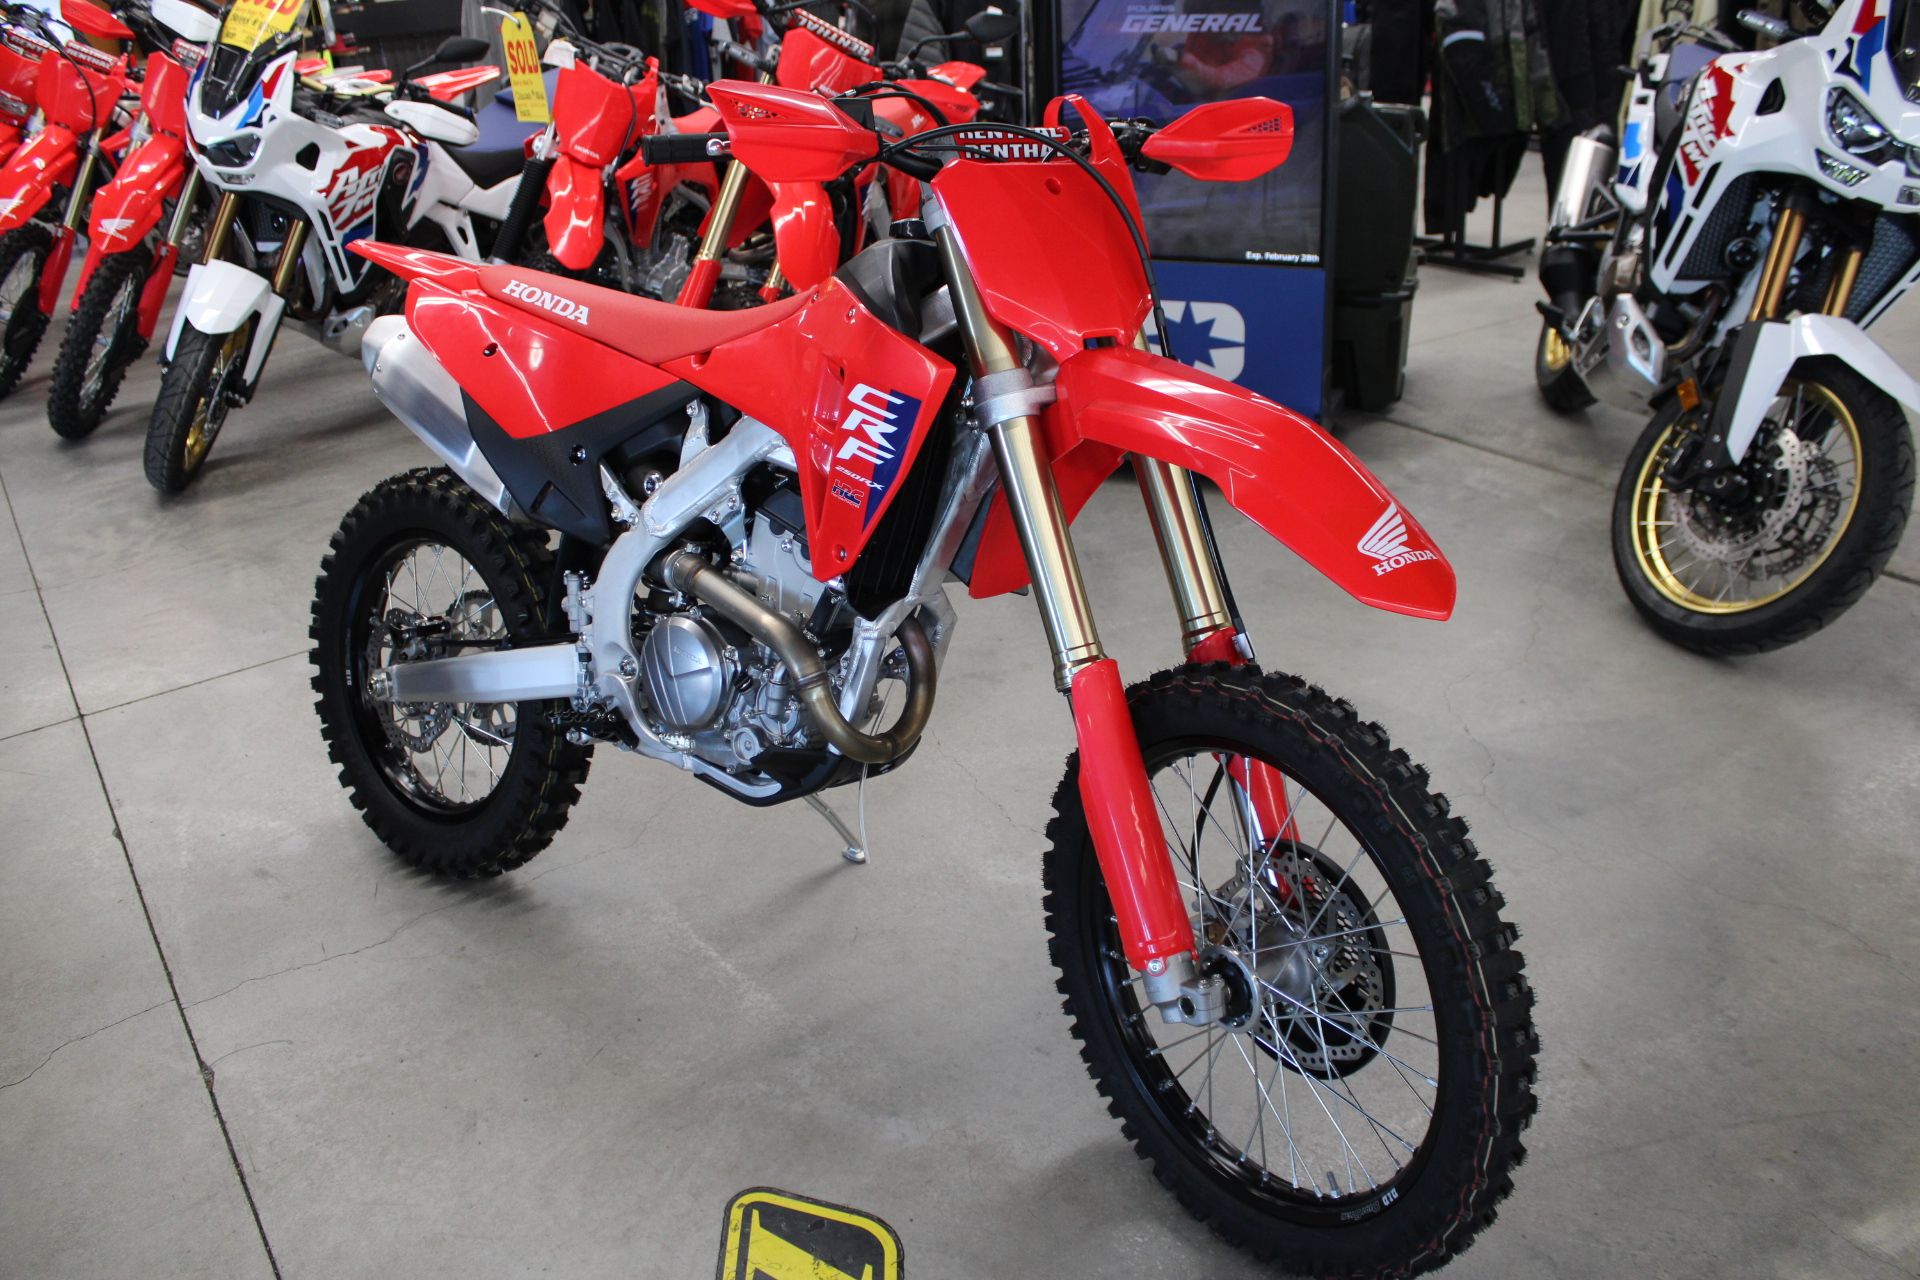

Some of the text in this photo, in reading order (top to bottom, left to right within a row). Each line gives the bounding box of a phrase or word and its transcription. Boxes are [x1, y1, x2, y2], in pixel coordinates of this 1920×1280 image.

[1120, 14, 1263, 32] GENERAL
[507, 40, 538, 75] SOLD
[1246, 251, 1320, 263] Exp. February 28th
[502, 279, 588, 325] HONDA
[836, 383, 905, 465] CRF
[835, 466, 885, 490] 250RX
[832, 479, 865, 505] HRC
[1371, 550, 1438, 576] HONDA
[1382, 1187, 1398, 1206] DID
